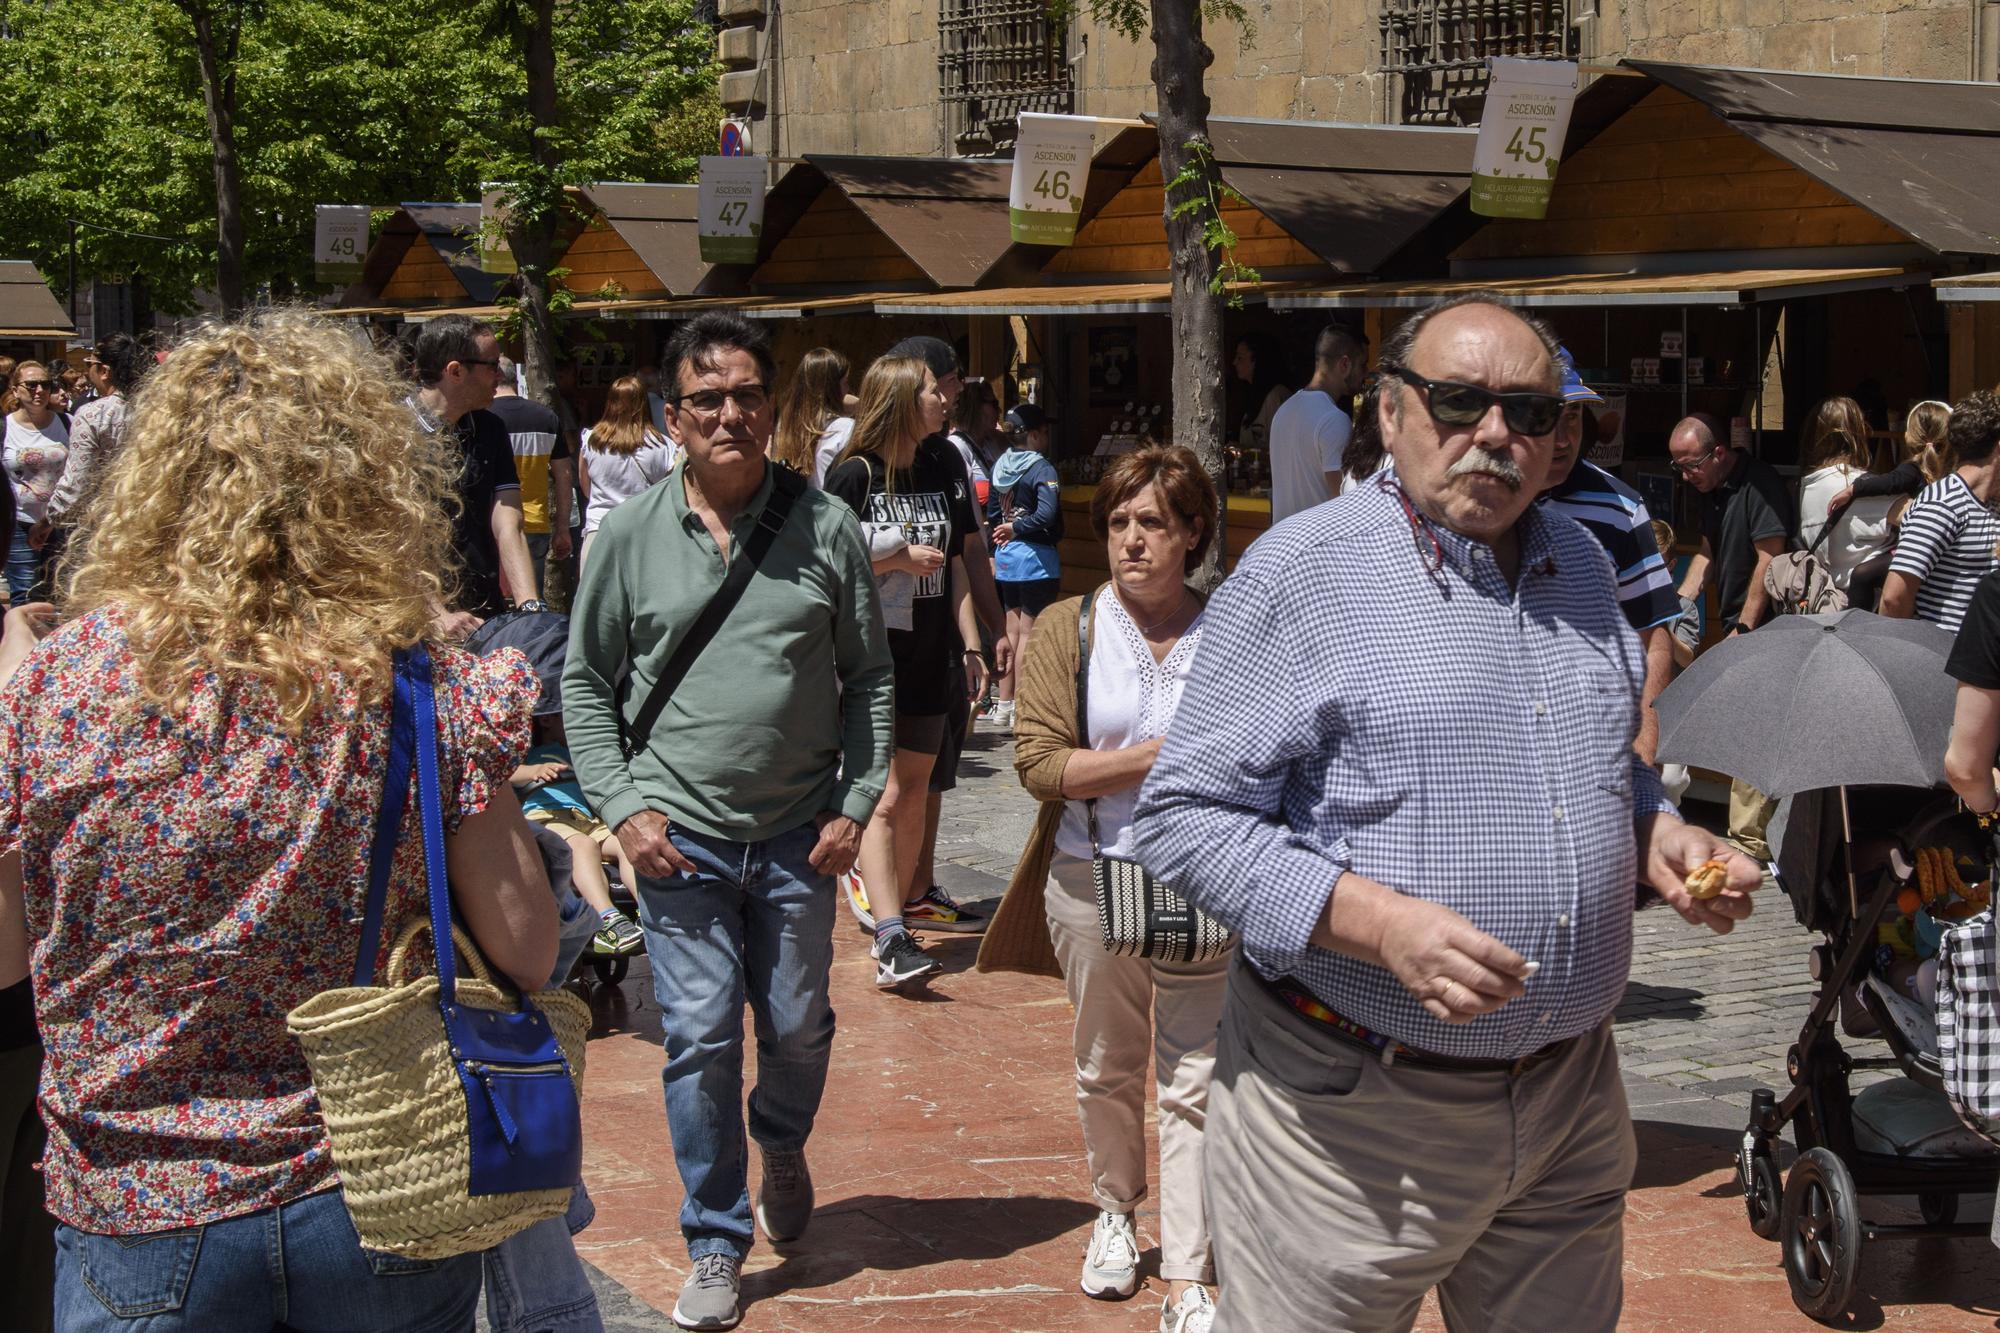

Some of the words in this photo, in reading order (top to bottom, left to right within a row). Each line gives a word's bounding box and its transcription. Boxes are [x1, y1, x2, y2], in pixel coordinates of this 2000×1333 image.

[1508, 103, 1556, 115] ASCENSIÓN
[1505, 126, 1547, 163] 45
[1034, 151, 1077, 161] ASCENSIÓN
[1033, 170, 1070, 200] 46
[719, 202, 748, 226] 47
[330, 237, 355, 256] 49
